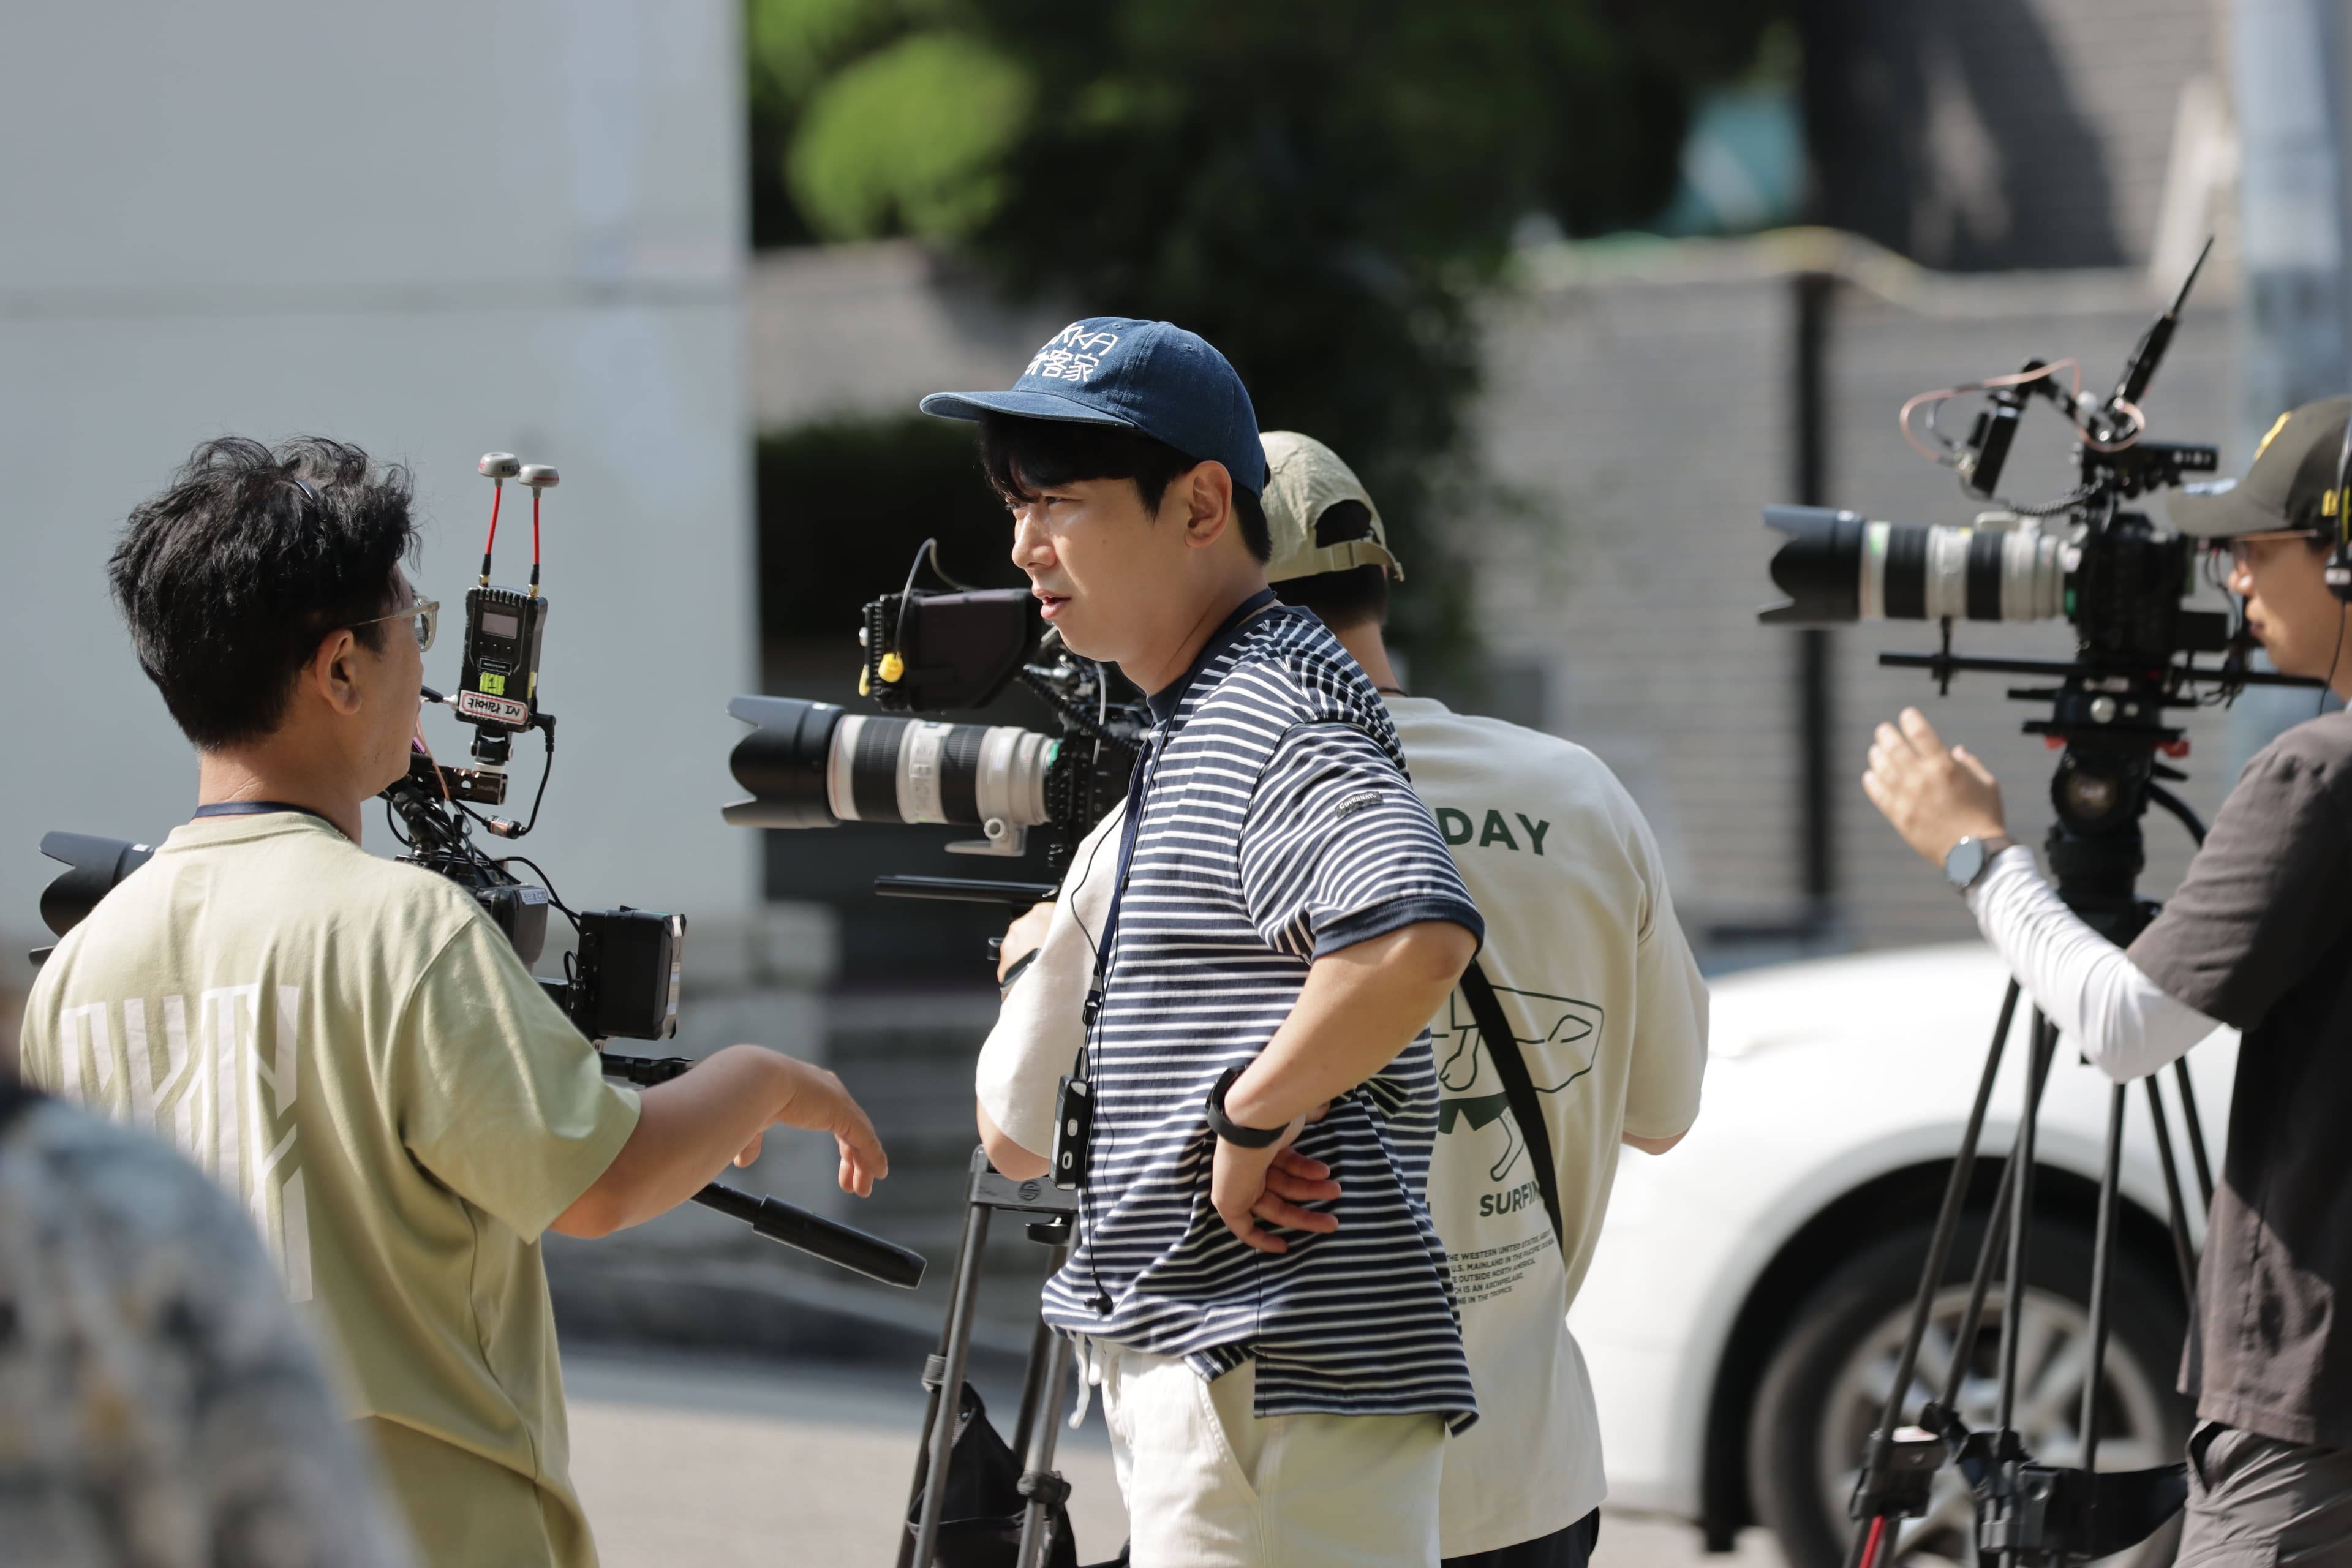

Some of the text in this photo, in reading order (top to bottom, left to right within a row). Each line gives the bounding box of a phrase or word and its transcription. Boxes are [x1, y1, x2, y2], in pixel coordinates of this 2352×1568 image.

[505, 705, 520, 717] IN
[1435, 807, 1550, 856] DAY
[1460, 1248, 1497, 1261] WESTERN
[1498, 1243, 1520, 1255] UNITED
[1451, 1264, 1464, 1273] U.S.
[1466, 1257, 1504, 1272] MAINLAND
[1512, 1252, 1522, 1262] THE
[1458, 1271, 1490, 1283] OUTSIDE
[1491, 1265, 1512, 1277] NORTH
[1468, 1295, 1476, 1304] IN
[1477, 1293, 1488, 1303] THE
